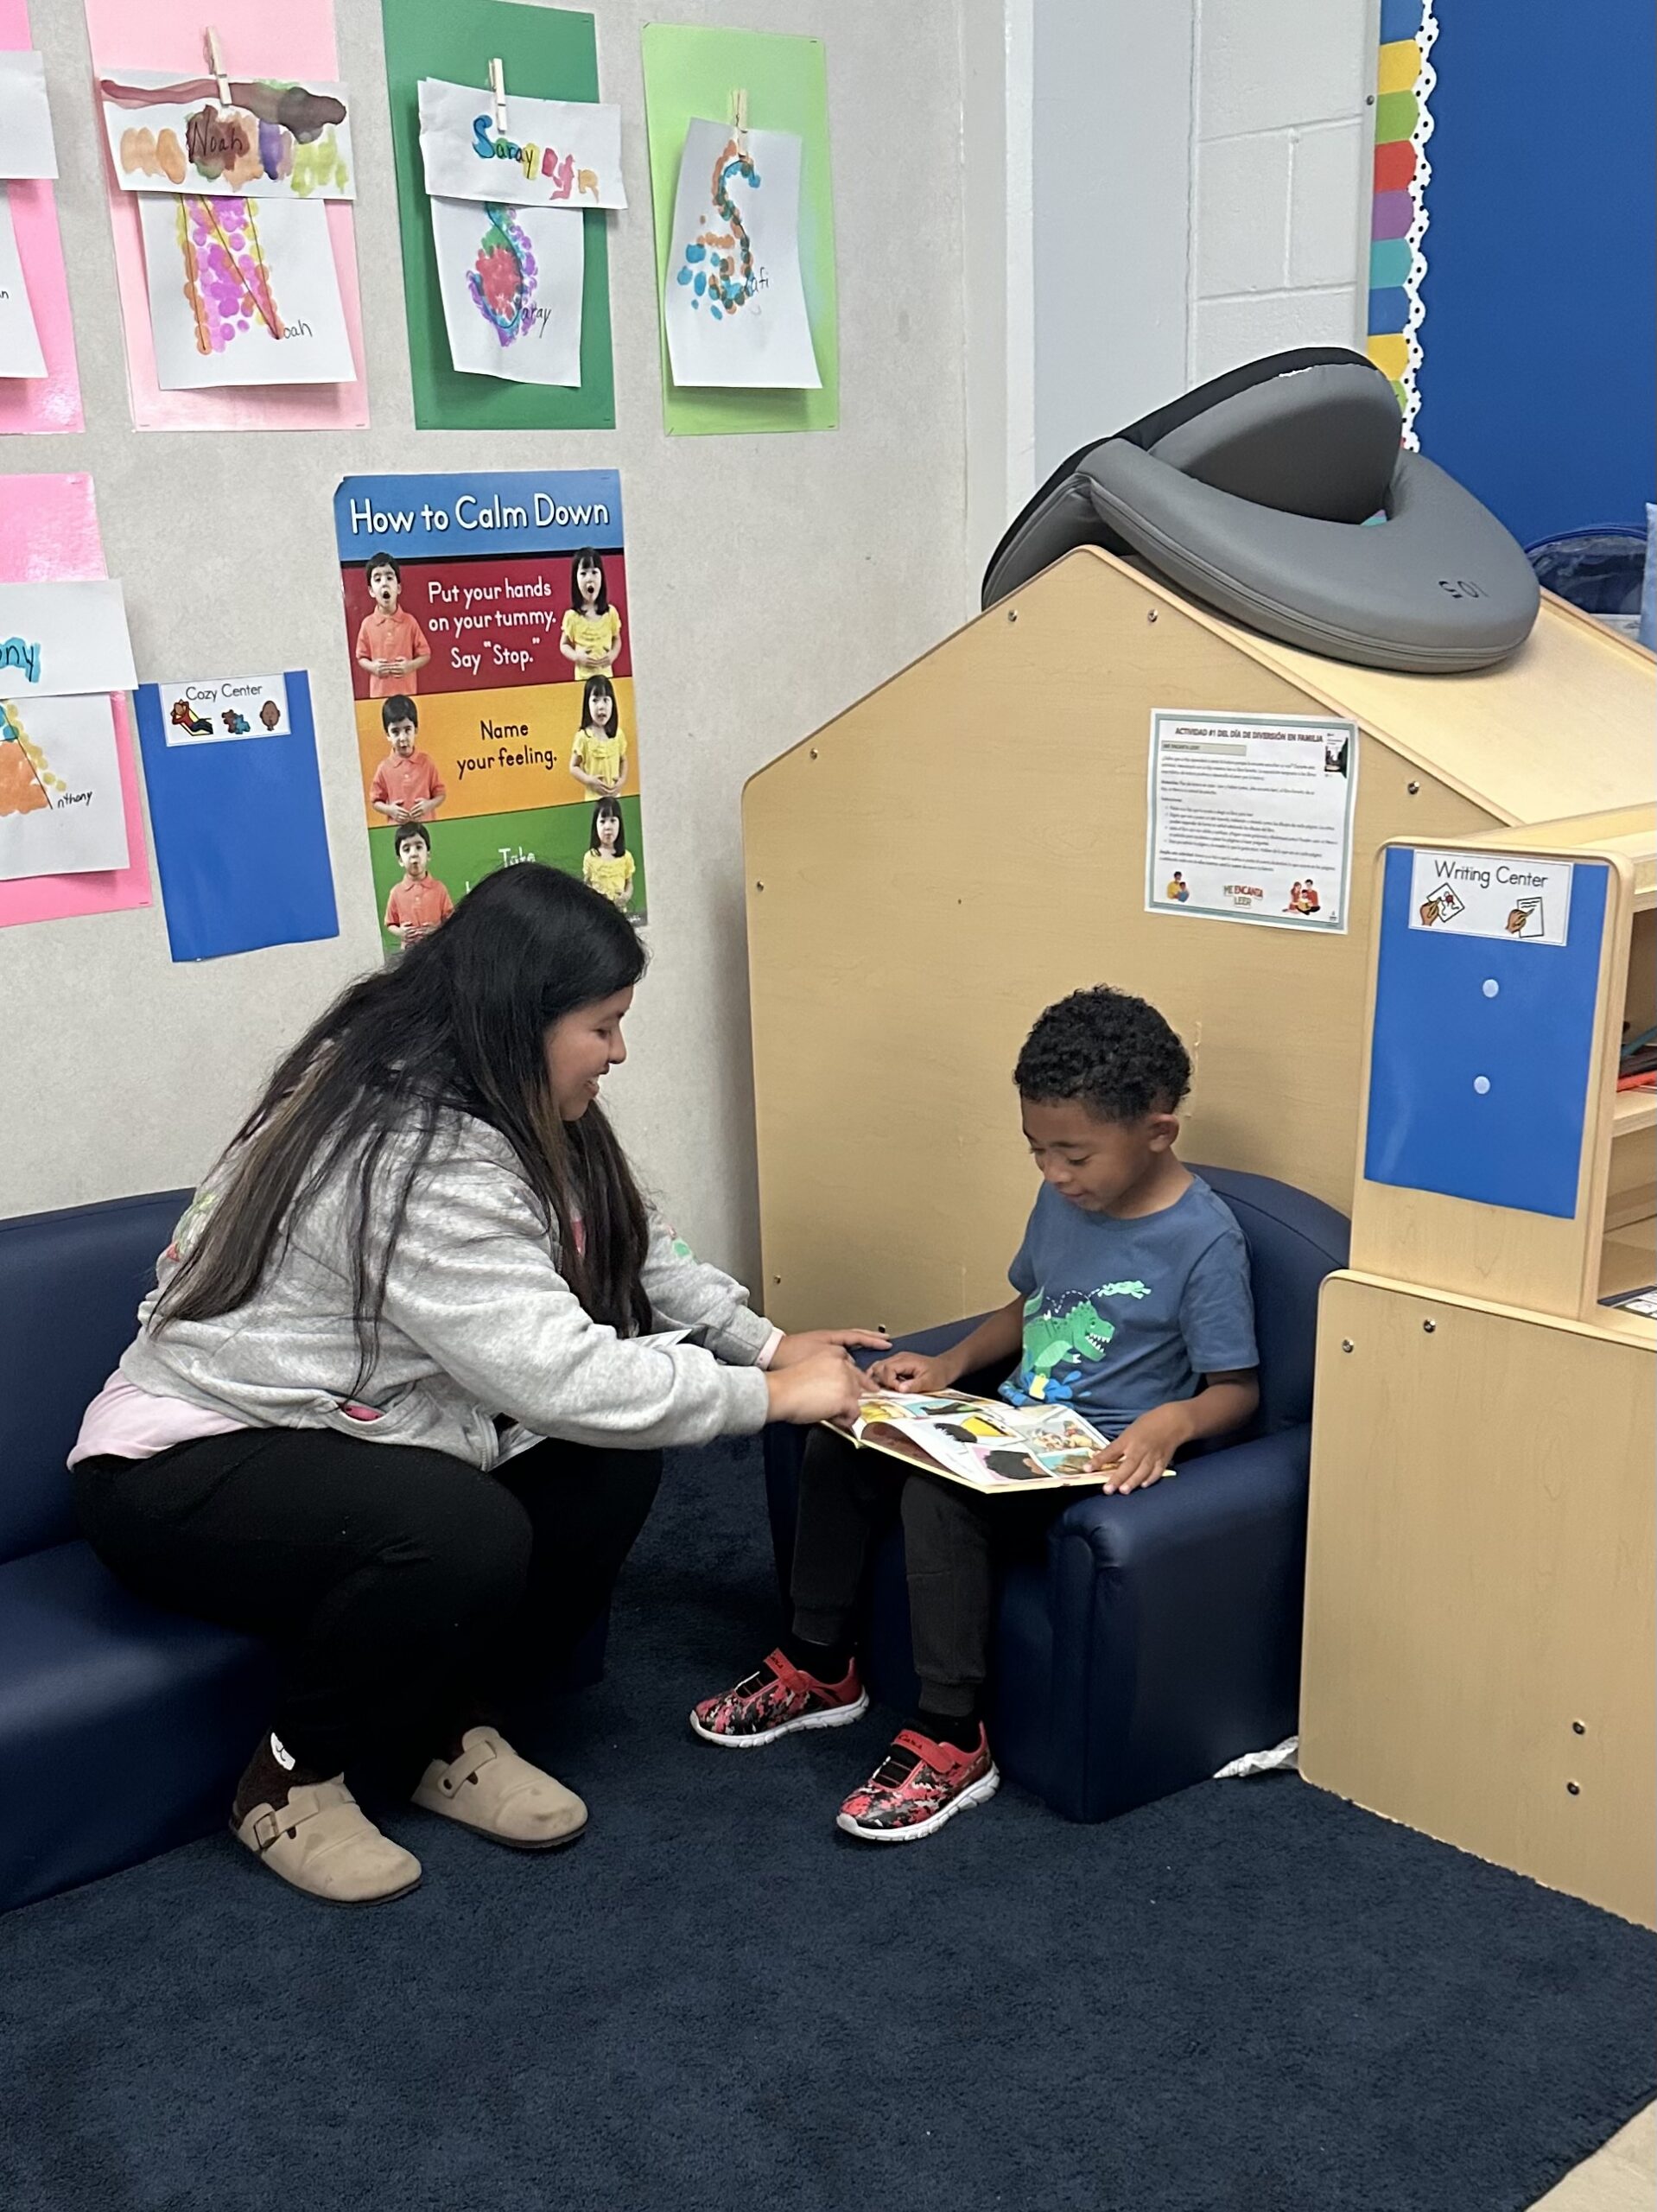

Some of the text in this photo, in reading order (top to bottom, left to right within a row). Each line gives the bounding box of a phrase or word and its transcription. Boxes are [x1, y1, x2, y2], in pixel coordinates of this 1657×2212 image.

[191, 118, 243, 156] Noah
[473, 115, 536, 180] Saray
[350, 492, 610, 535] How to Calm Down
[428, 575, 552, 610] Put your hands
[429, 610, 556, 639] on your tummy.
[0, 644, 35, 683] ny
[451, 636, 540, 675] Say "Stop."
[186, 683, 263, 702] Cozy Center
[479, 720, 529, 741] Name
[1175, 728, 1208, 736] ACTIVIDAD
[1217, 729, 1228, 738] DEL
[1242, 730, 1252, 739] DE
[1287, 733, 1296, 741] EN
[1298, 734, 1324, 743] FAMILIA
[457, 745, 557, 780] your feeling.
[1434, 859, 1549, 889] Writing Center
